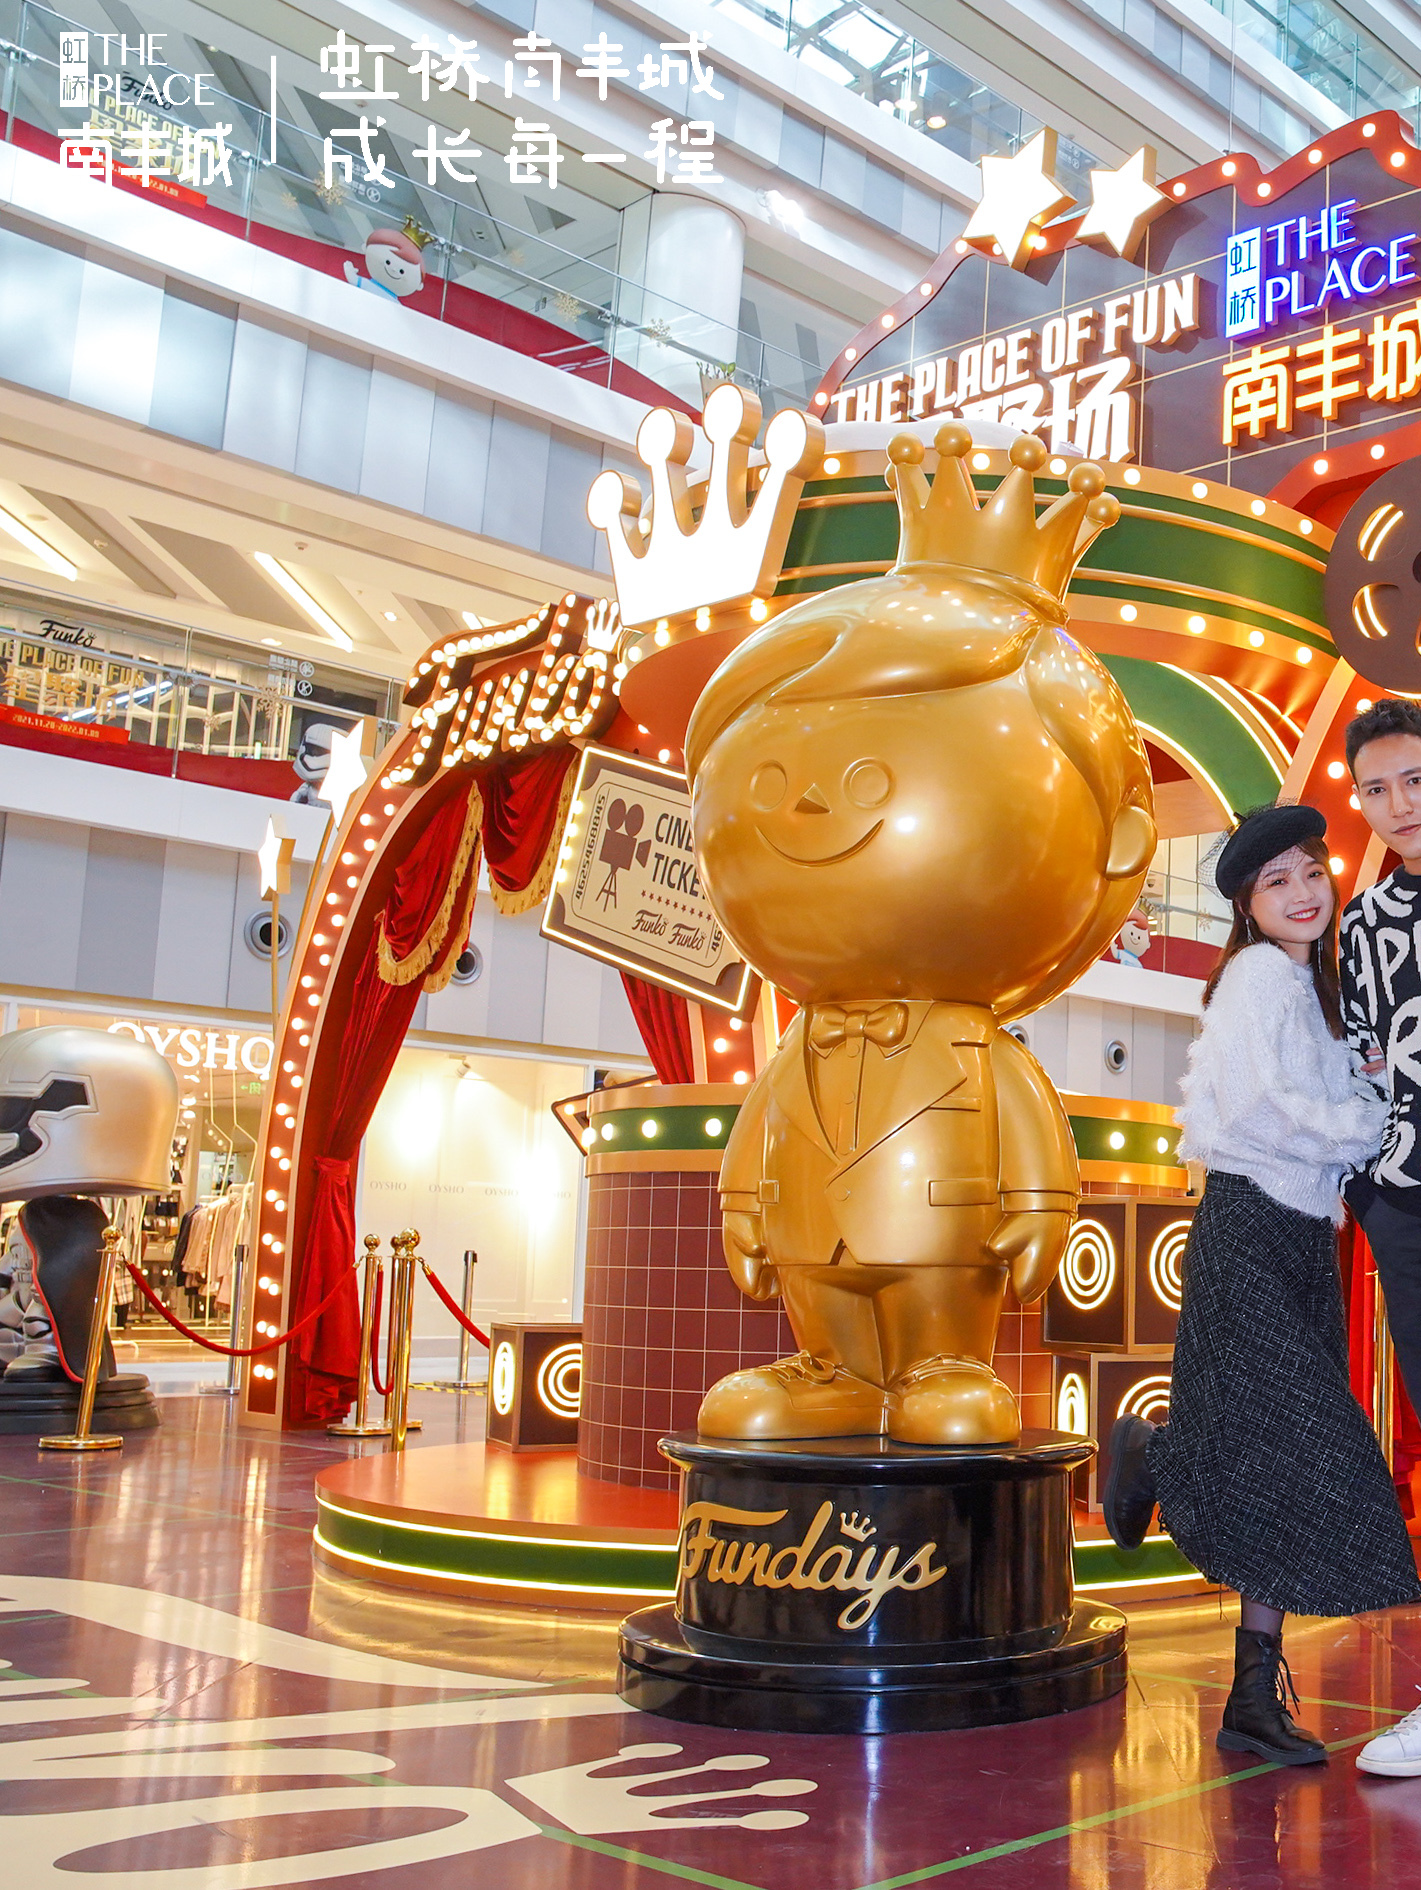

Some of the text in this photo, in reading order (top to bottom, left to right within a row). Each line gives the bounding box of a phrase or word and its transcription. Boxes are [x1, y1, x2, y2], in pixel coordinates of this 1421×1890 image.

[1266, 198, 1362, 267] THE
[1229, 235, 1258, 326] 虹桥
[1264, 233, 1421, 324] PLACE
[908, 332, 1034, 416] PLACE
[1040, 306, 1102, 374] OF
[1104, 270, 1202, 350] FUN
[40, 619, 97, 648] Funko
[20, 644, 76, 673] PLACE
[107, 664, 144, 689] FUN
[652, 852, 706, 900] TICKE
[631, 908, 706, 951] Funko Funko
[369, 1180, 407, 1192] OYSHO
[428, 1184, 465, 1195] OYSHO
[682, 1500, 948, 1631] Fundays
